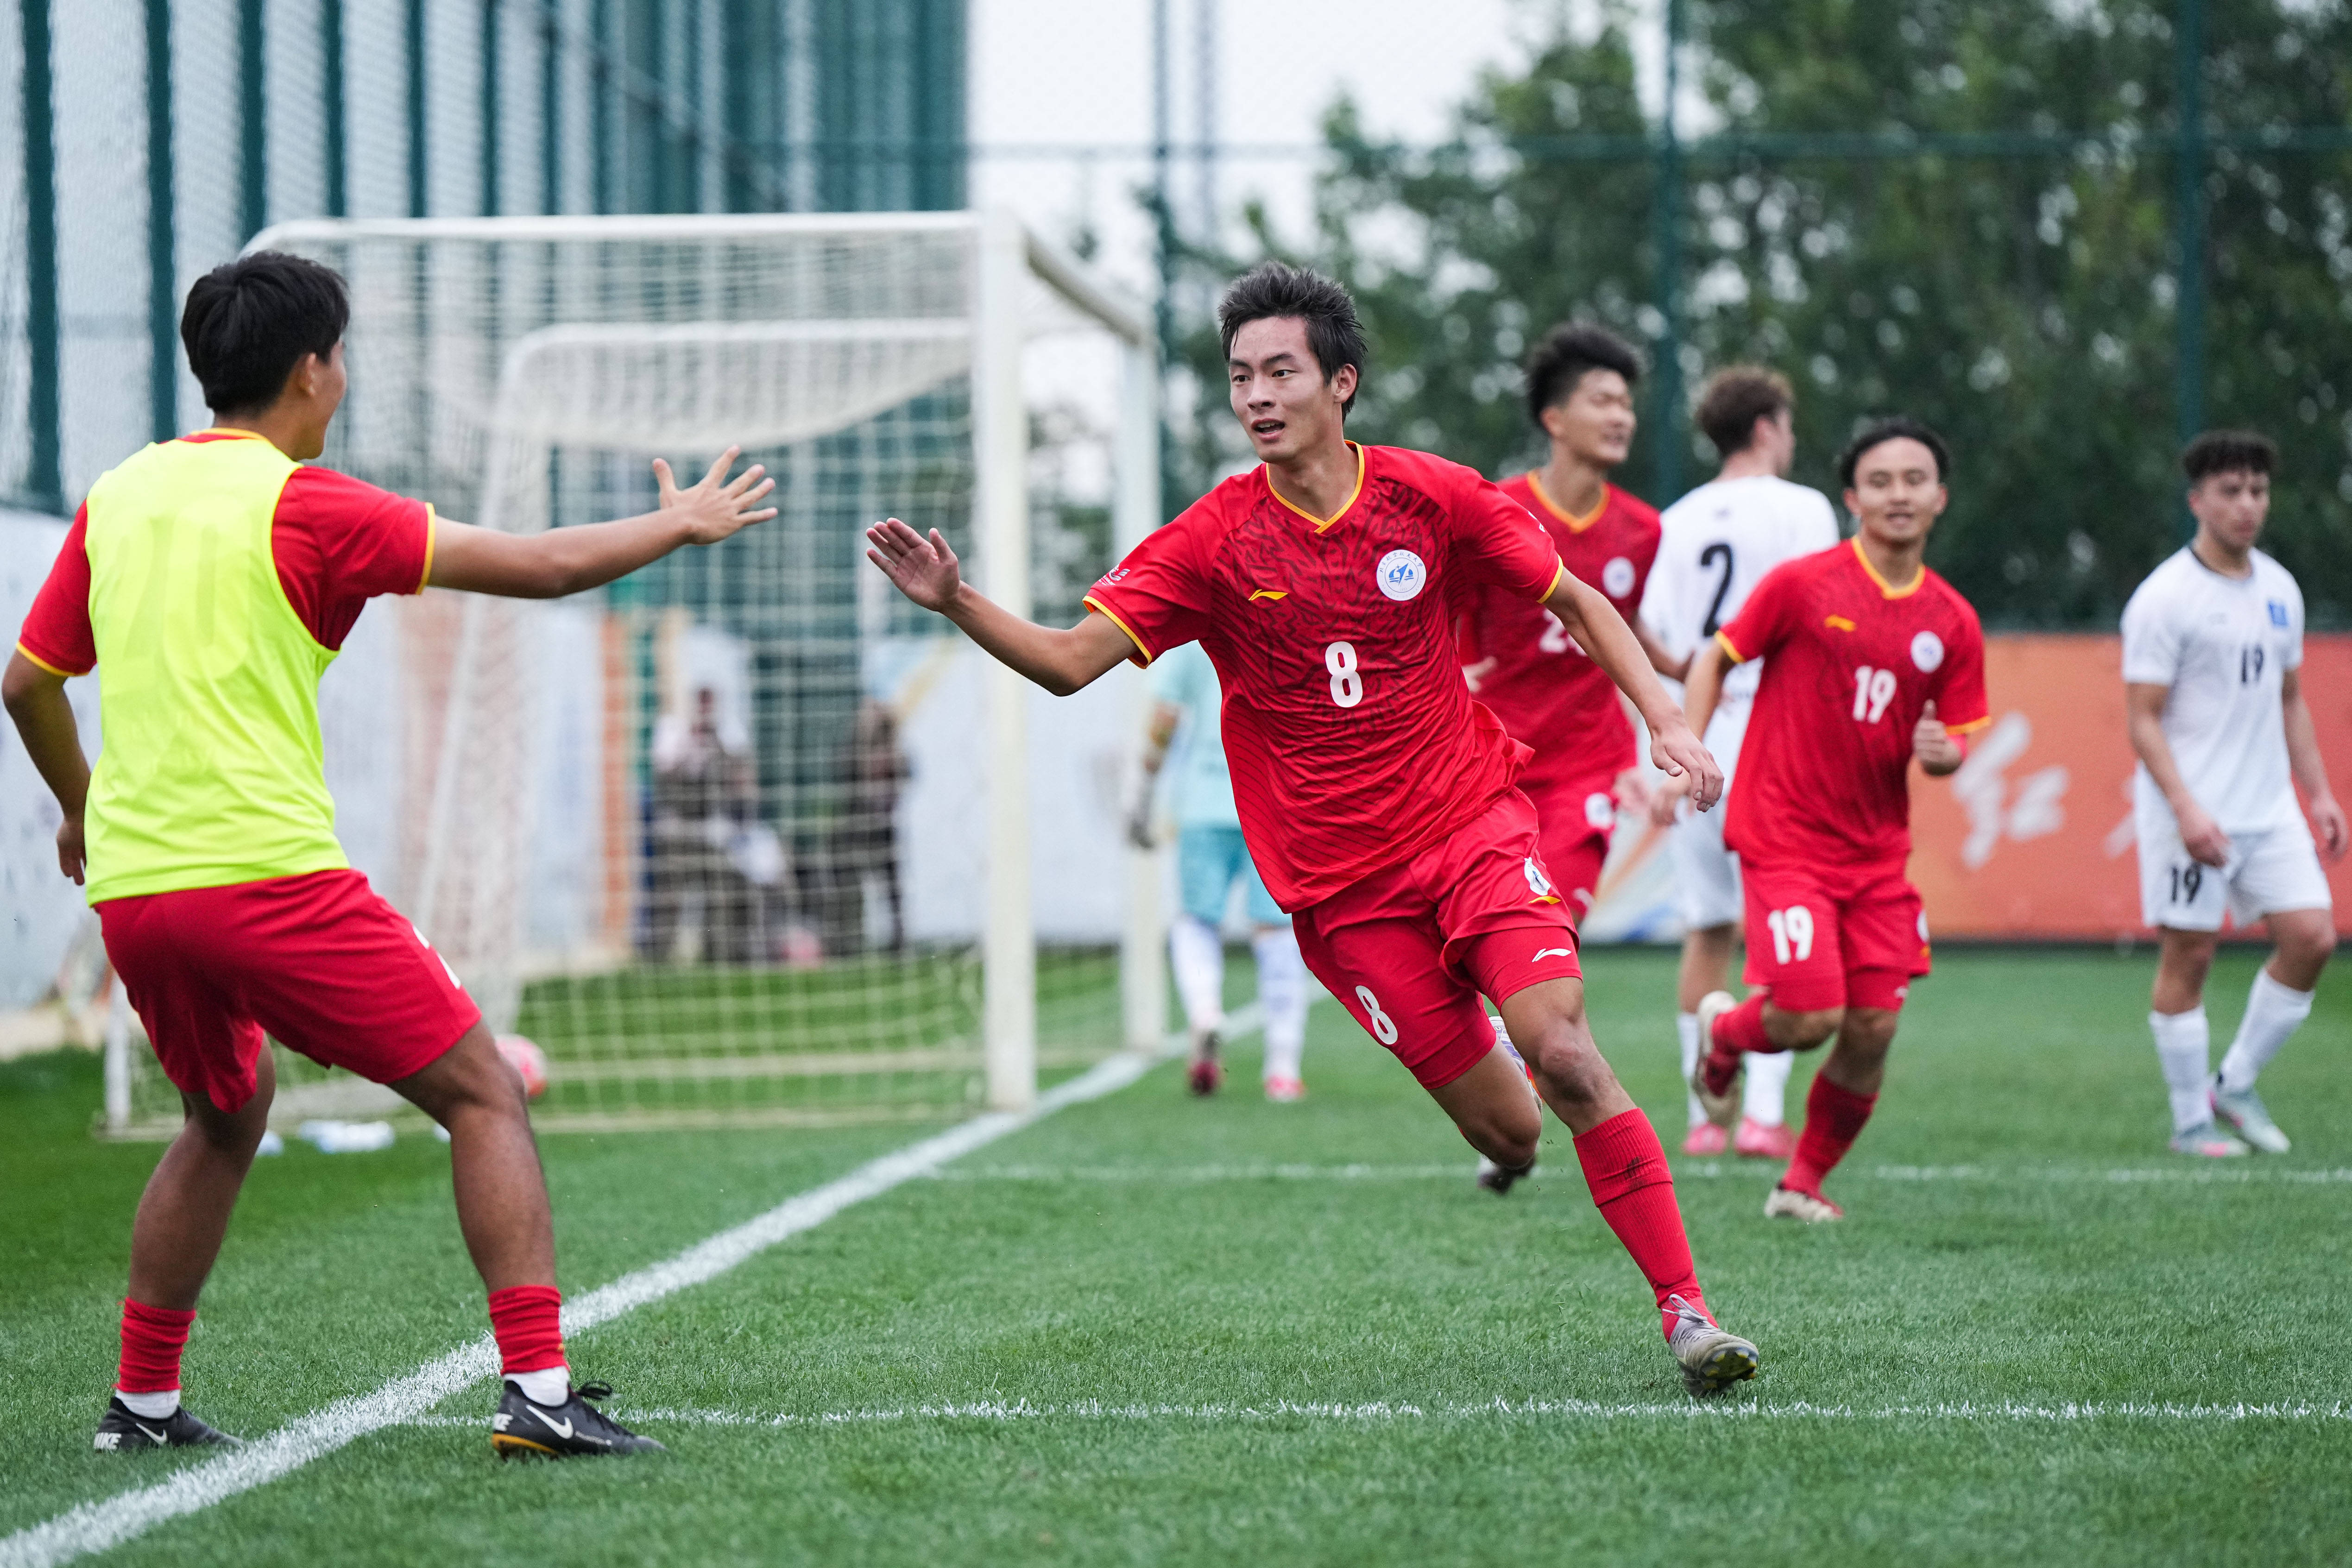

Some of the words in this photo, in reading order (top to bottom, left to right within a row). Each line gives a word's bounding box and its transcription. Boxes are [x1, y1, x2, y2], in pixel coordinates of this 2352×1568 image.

[1701, 544, 1733, 637] 2
[1539, 608, 1588, 657] 2
[1325, 641, 1363, 708] 8
[2241, 646, 2264, 684] 19
[1853, 666, 1897, 724] 19
[2171, 863, 2202, 903] 19
[1767, 905, 1814, 964] 19
[1355, 985, 1398, 1045] 8
